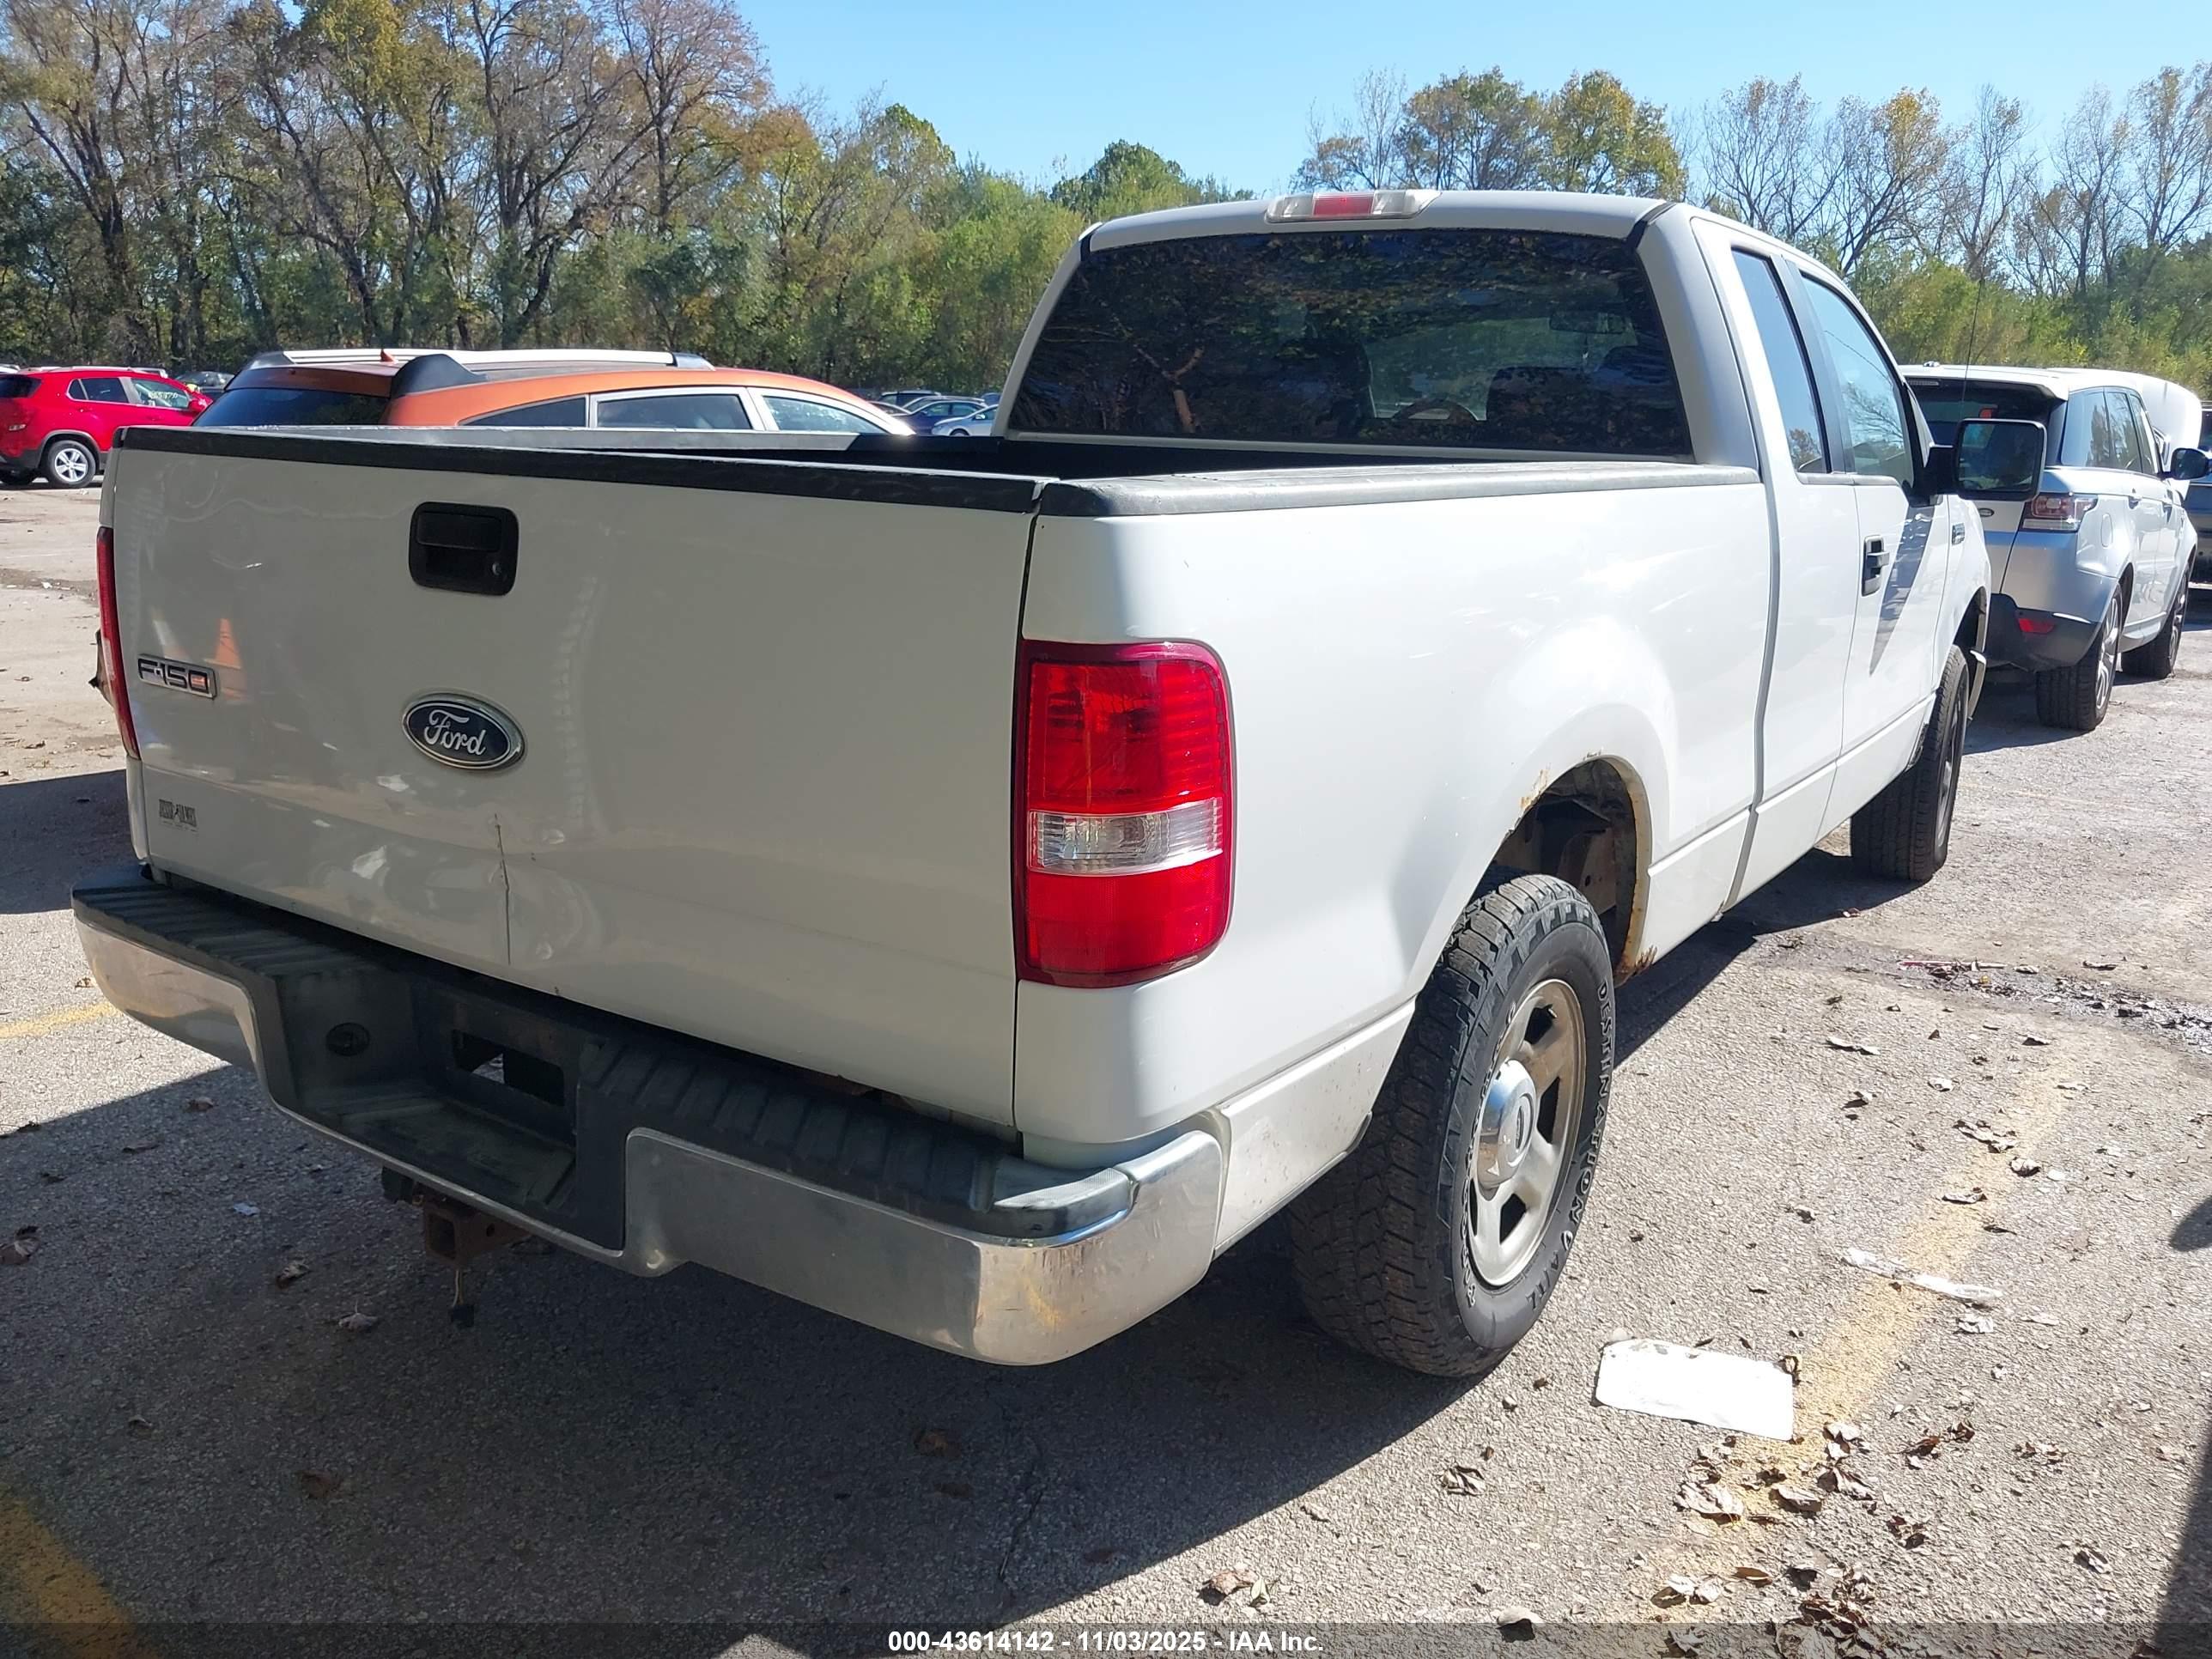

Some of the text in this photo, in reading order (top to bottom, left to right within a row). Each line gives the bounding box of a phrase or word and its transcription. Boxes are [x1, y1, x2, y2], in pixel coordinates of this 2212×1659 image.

[138, 658, 210, 694] F-150
[424, 709, 486, 755] Ford
[1570, 979, 1613, 1223] DESTINATION
